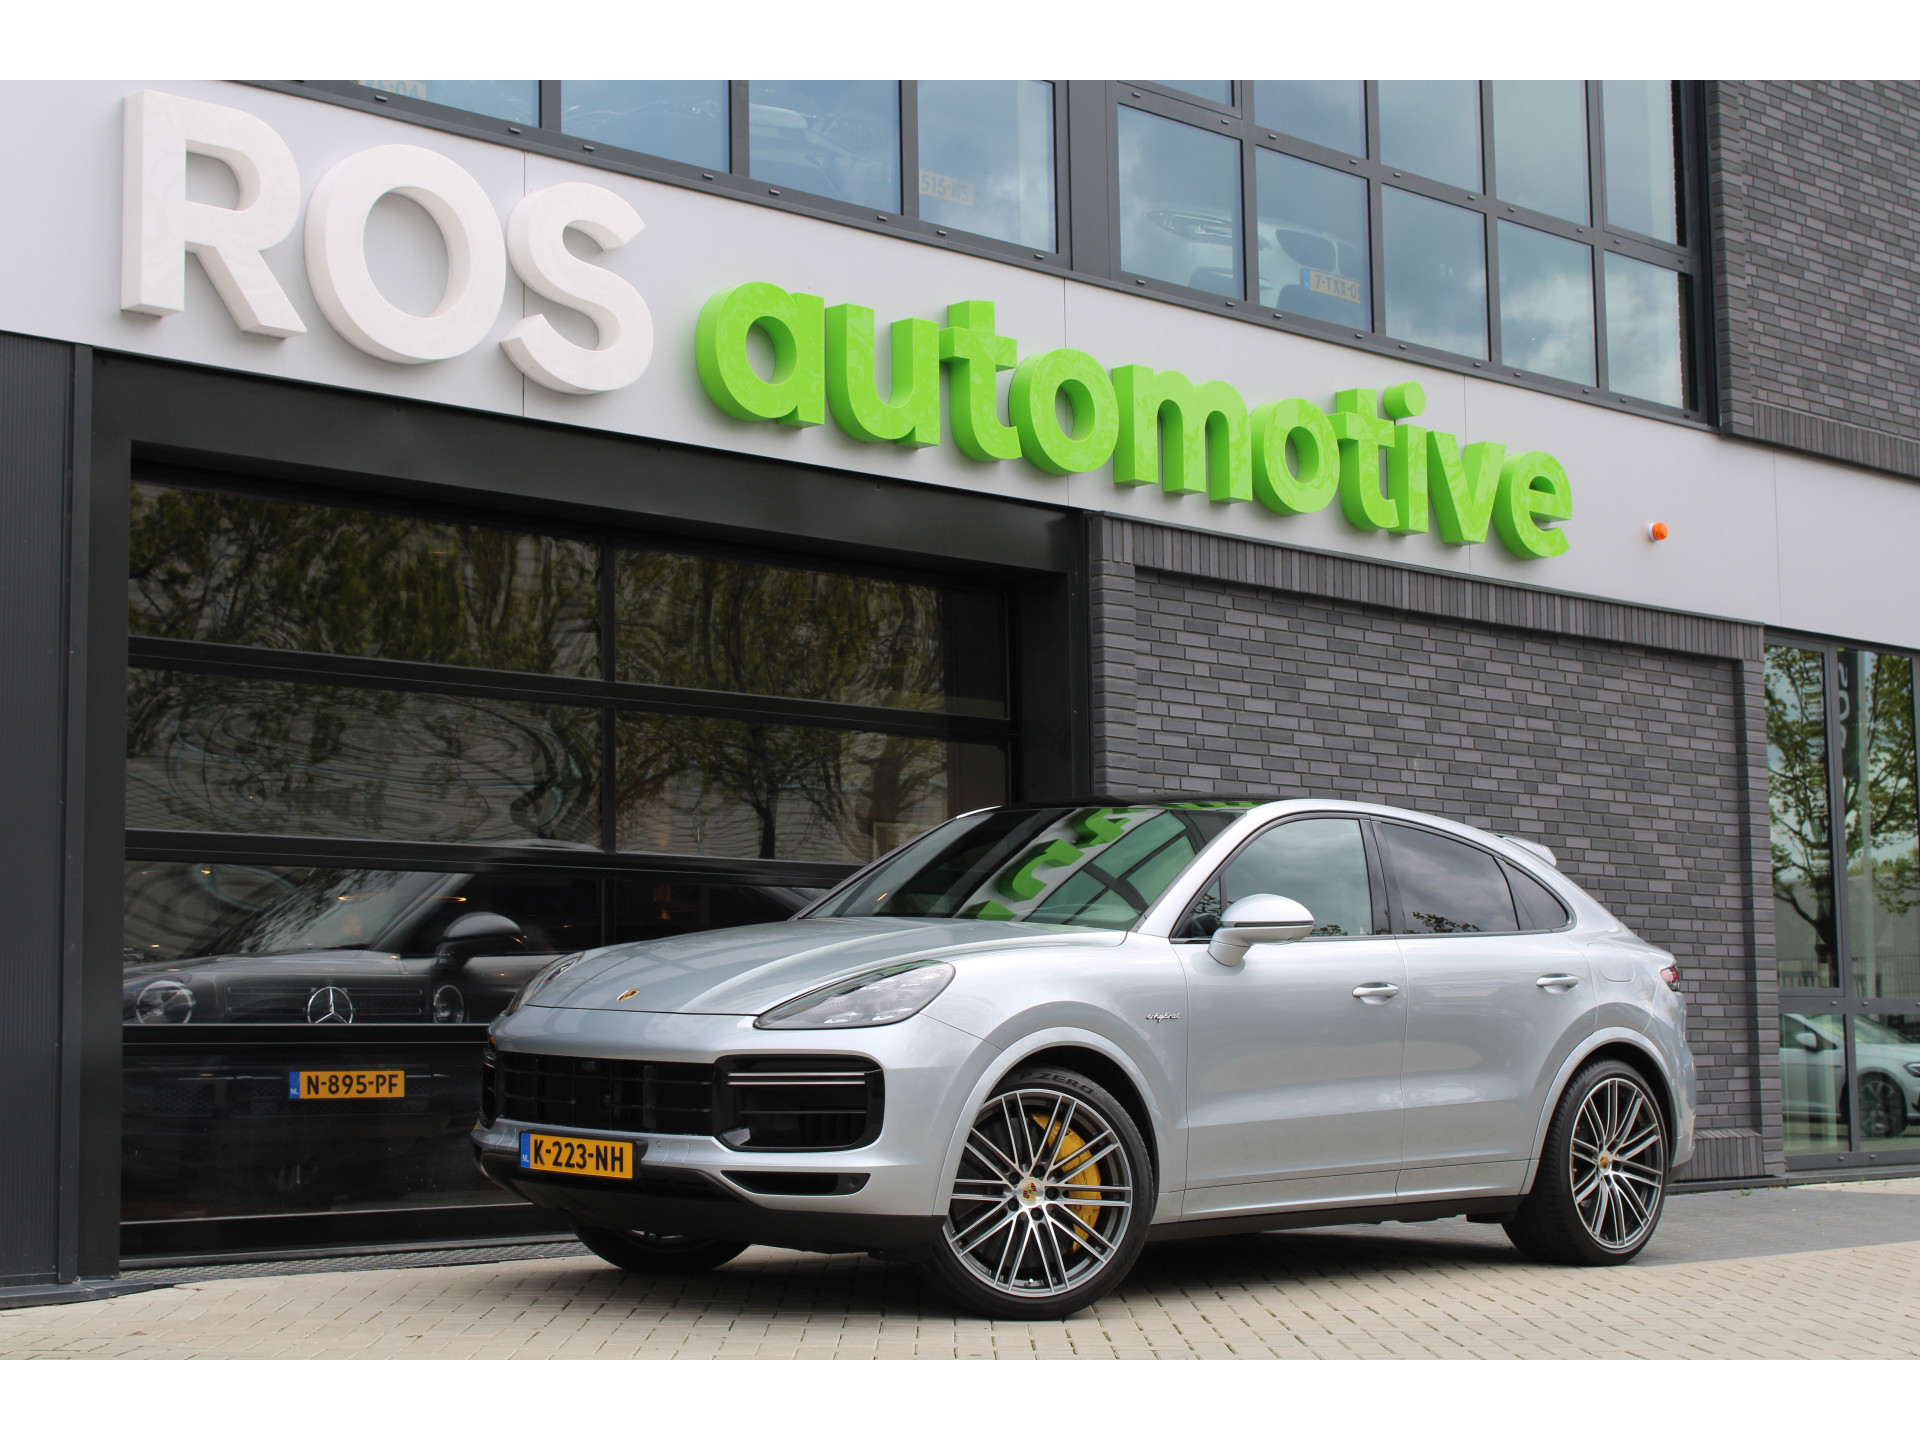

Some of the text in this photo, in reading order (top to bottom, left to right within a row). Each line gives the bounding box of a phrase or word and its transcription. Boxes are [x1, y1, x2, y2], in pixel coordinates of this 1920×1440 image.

[1314, 273, 1361, 299] 7-TXX-0
[120, 88, 1573, 560] ROS automotive
[306, 1074, 399, 1095] N-895-PF
[1038, 1072, 1095, 1095] ZERO
[522, 1139, 624, 1173] NL K-223-NH
